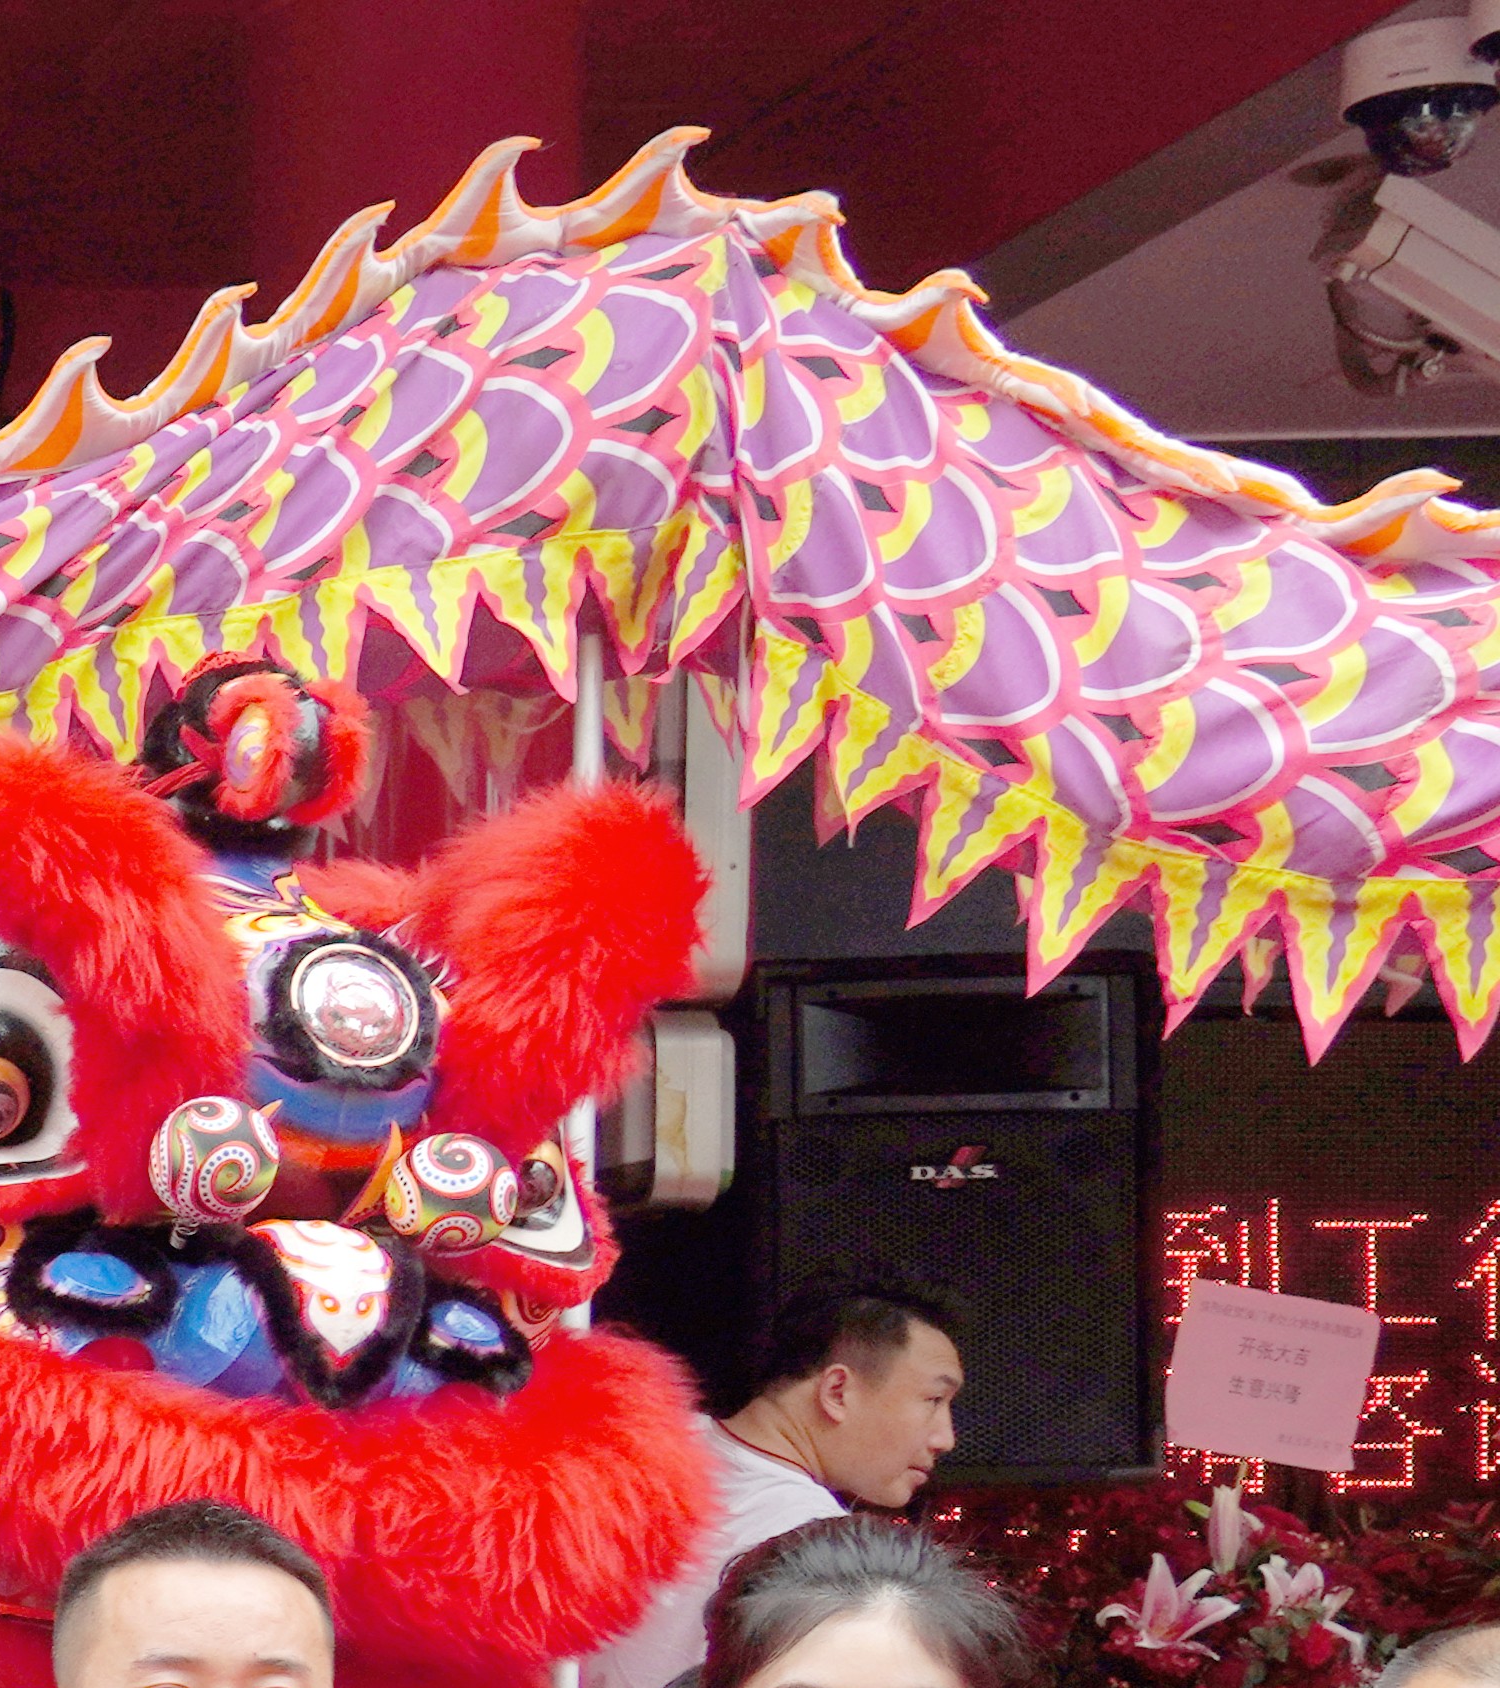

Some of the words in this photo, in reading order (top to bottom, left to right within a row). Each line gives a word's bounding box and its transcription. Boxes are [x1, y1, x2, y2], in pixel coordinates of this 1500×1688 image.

[1238, 1336, 1311, 1367] 开张大吉
[1228, 1374, 1301, 1405] 生意兴隆
